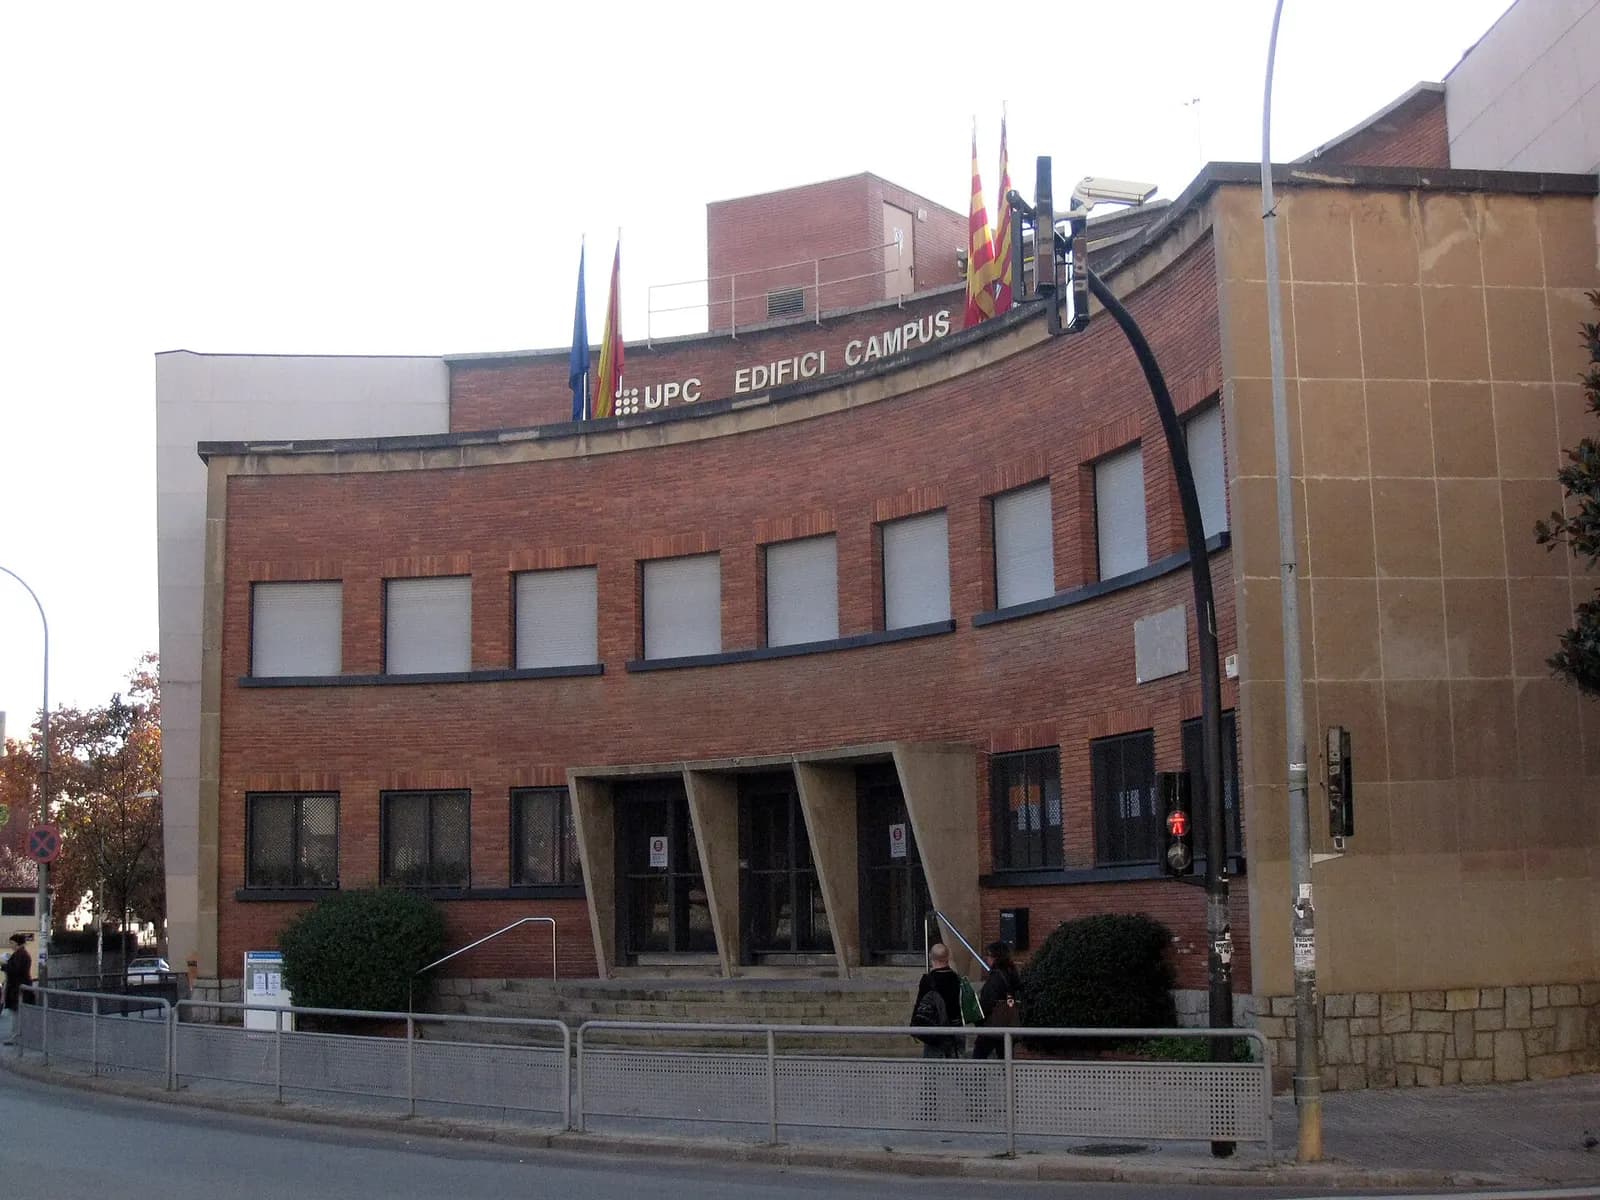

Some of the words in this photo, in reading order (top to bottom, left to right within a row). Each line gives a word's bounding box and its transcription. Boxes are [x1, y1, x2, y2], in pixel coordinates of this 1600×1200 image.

[645, 378, 701, 409] UPC
[735, 350, 826, 393] EDIFICI
[844, 310, 950, 365] CAMPUS
